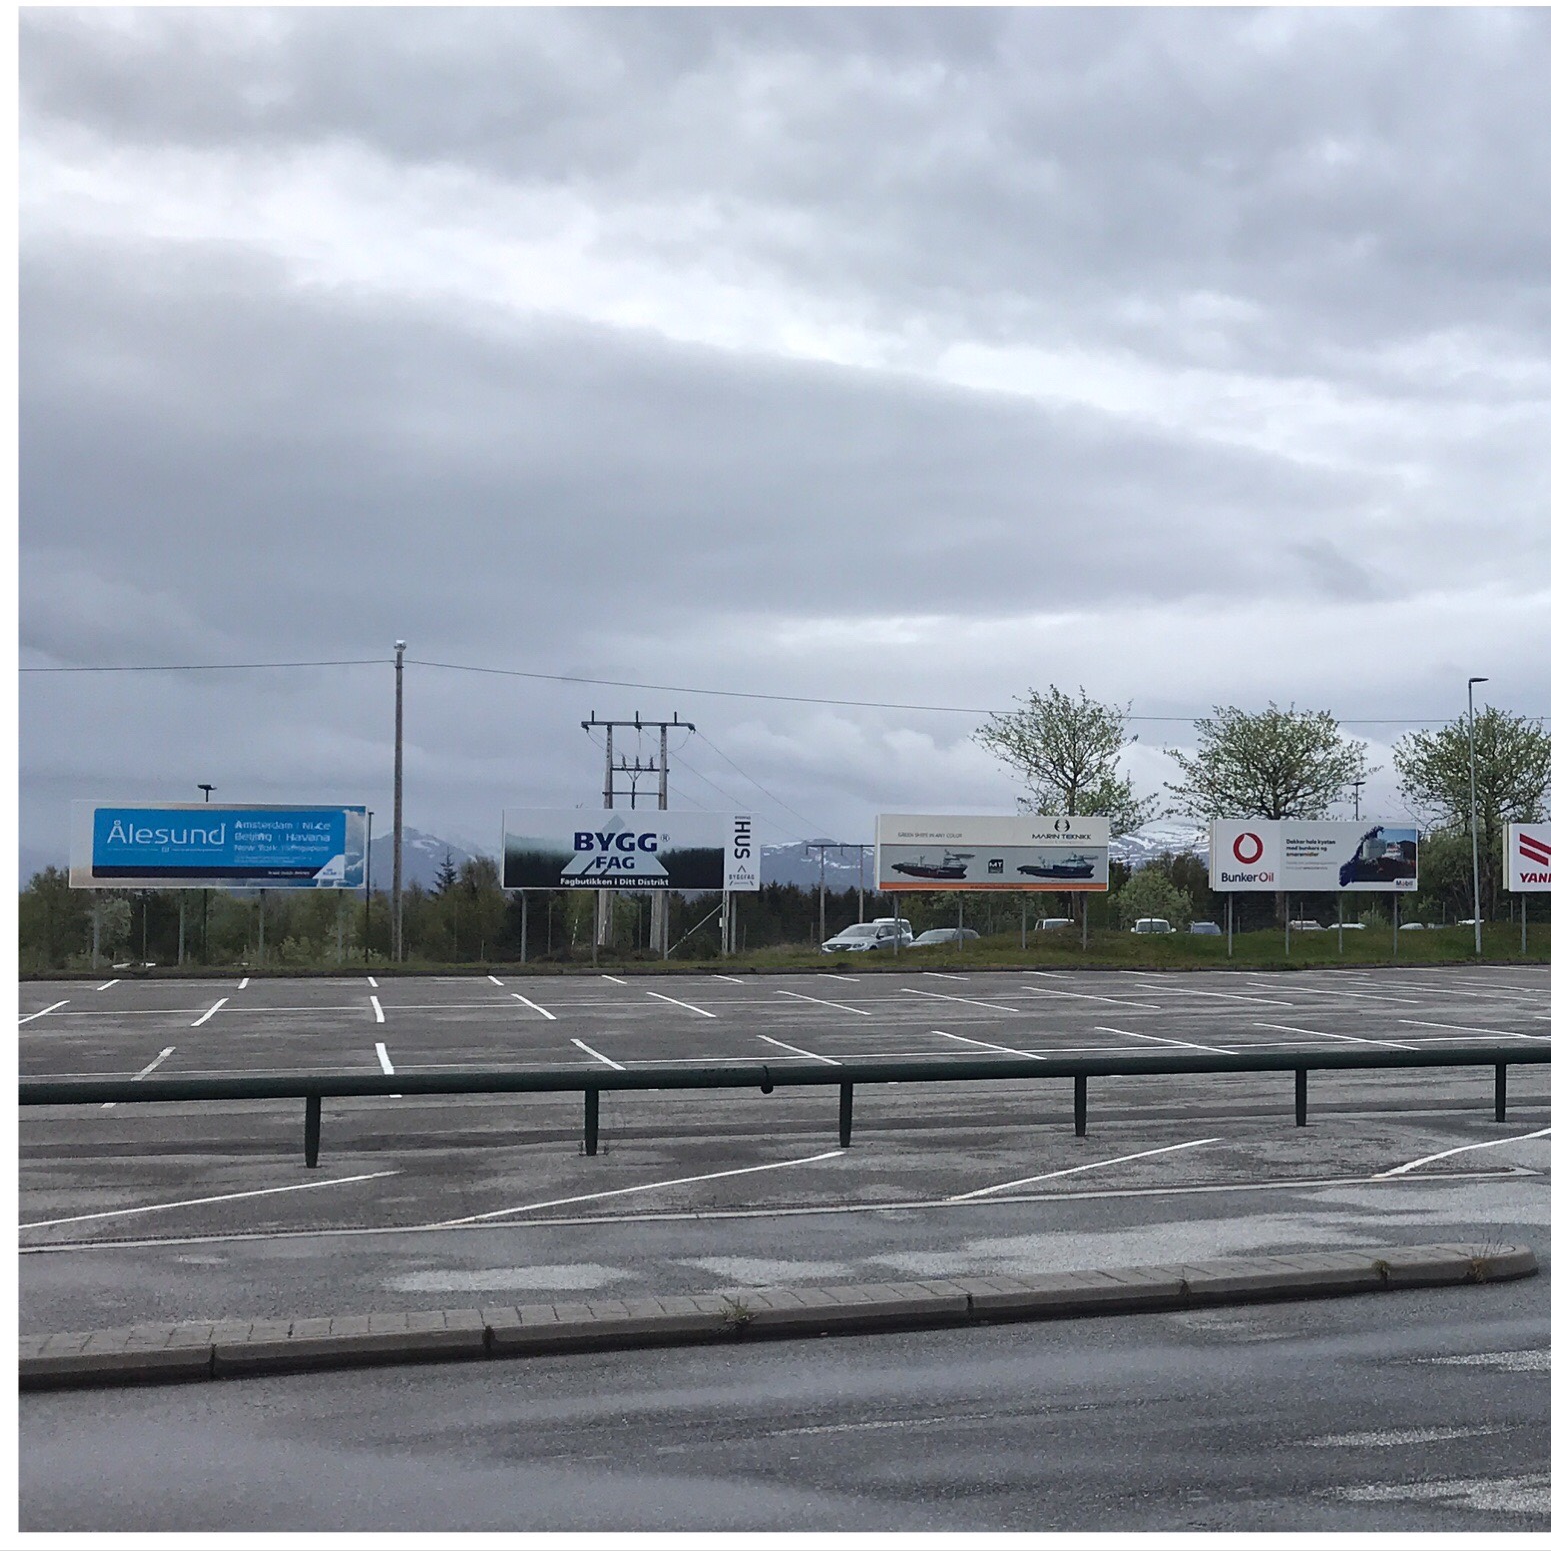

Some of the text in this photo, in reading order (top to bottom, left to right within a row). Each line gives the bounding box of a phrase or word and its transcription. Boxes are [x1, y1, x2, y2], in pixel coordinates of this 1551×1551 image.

[235, 820, 293, 829] Amsterdam
[107, 819, 226, 845] Ålesund
[286, 833, 331, 842] Havana
[574, 832, 657, 852] BYGG
[734, 821, 751, 859] HUS
[595, 856, 635, 869] FAG
[560, 878, 613, 887] Fagbutikken
[638, 878, 669, 886] Distrikt
